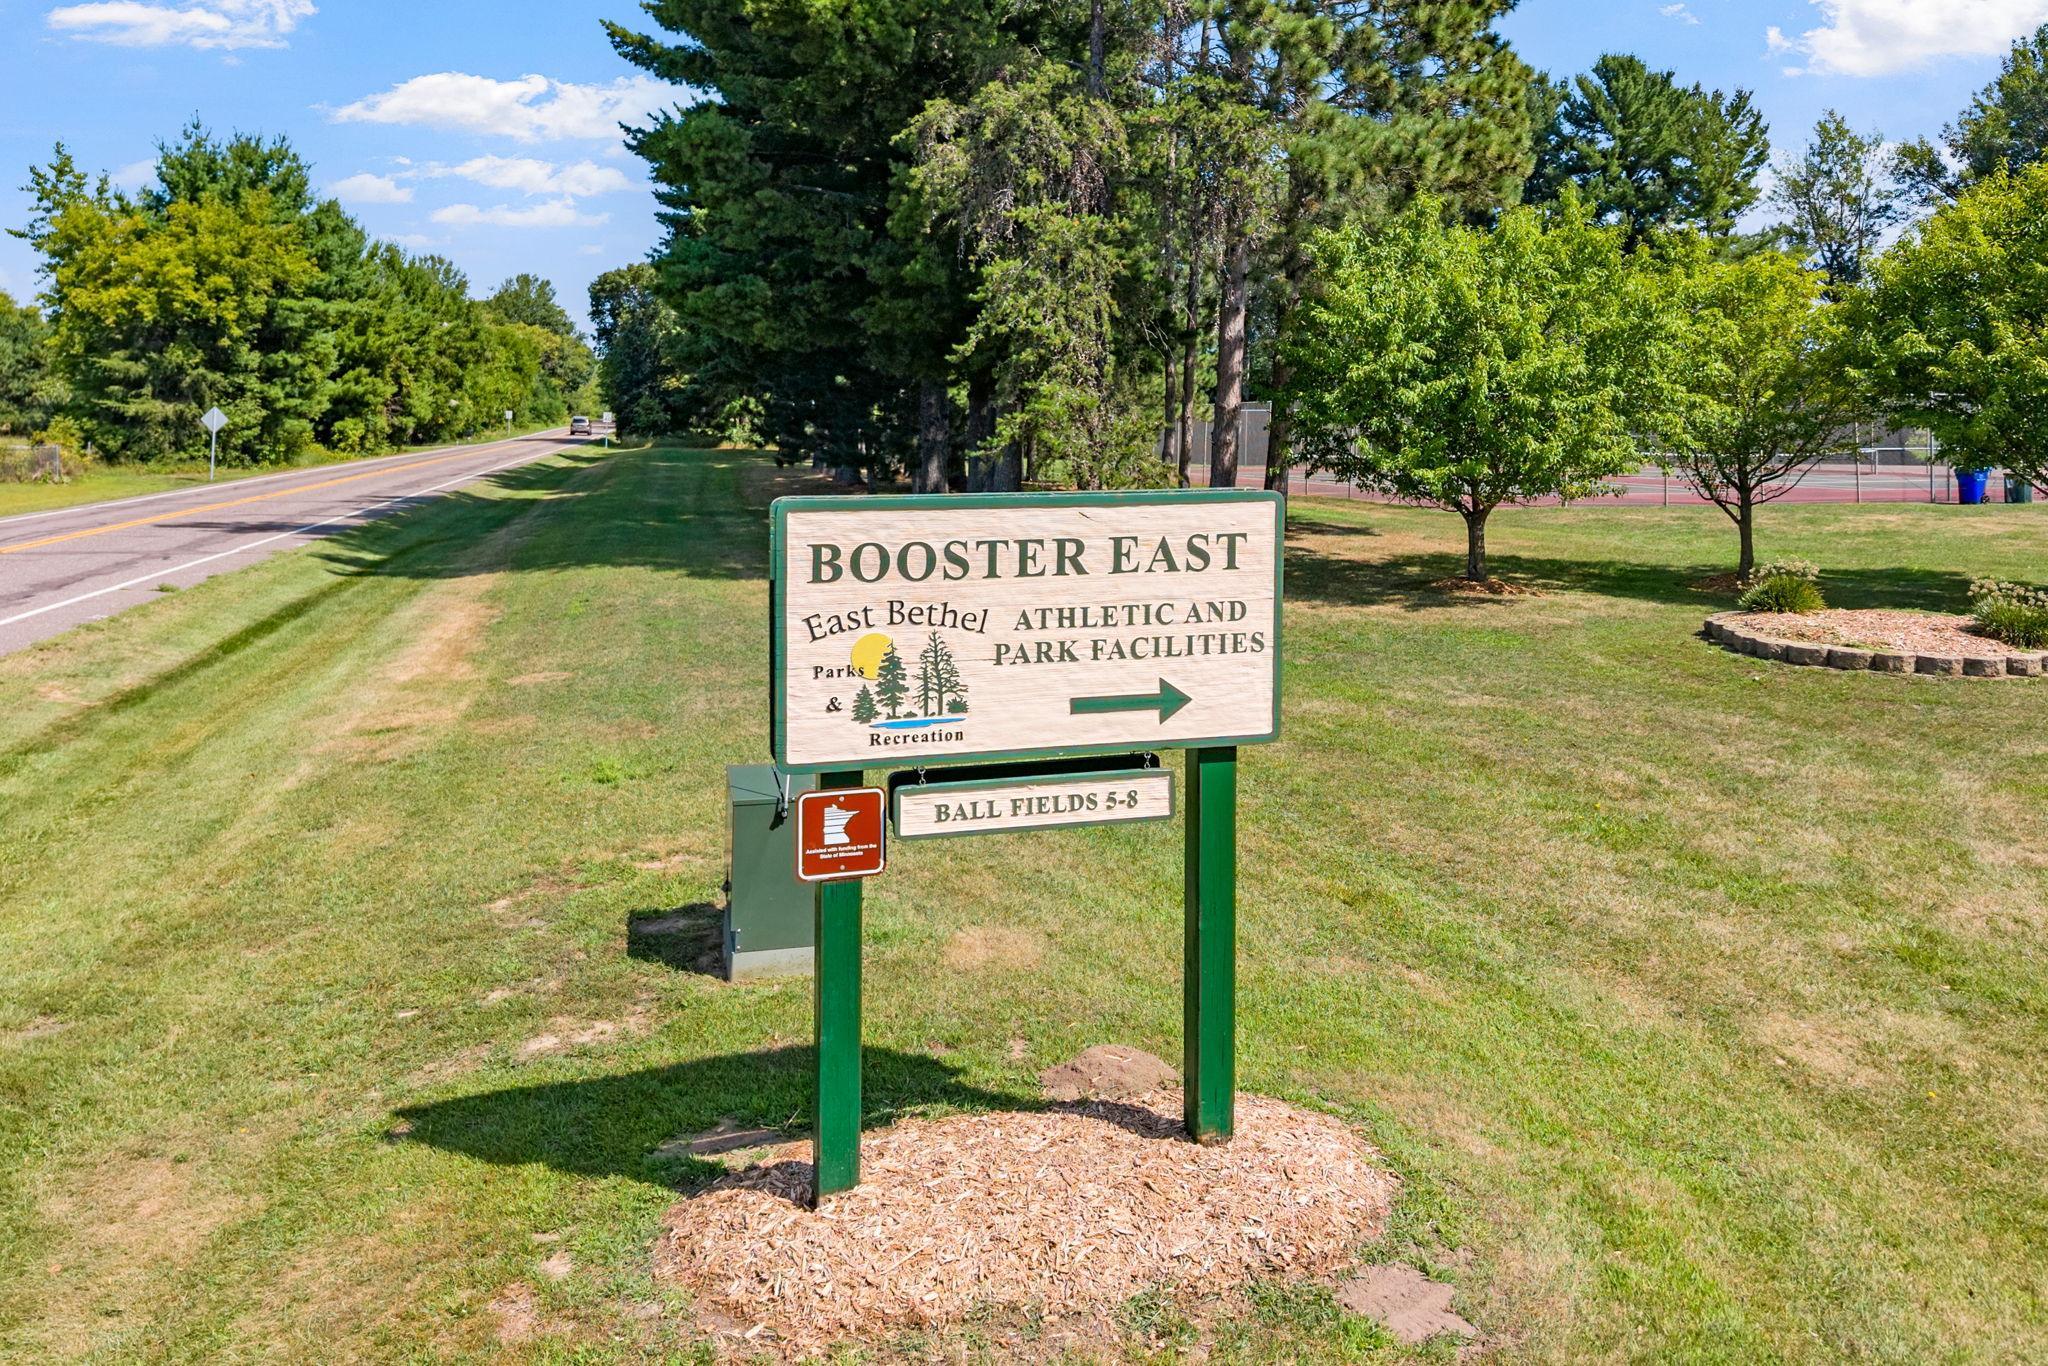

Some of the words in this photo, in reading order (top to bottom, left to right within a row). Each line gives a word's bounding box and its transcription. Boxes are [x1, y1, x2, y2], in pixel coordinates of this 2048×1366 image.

[806, 538, 1090, 584] BOOSTER
[1107, 533, 1248, 575] EAST
[801, 605, 876, 643] East
[886, 600, 988, 634] Bethel
[1013, 603, 1175, 631] ATHLETIC
[1184, 600, 1248, 623] AND
[993, 640, 1080, 666] PARK
[1090, 631, 1265, 661] FACILITIES
[812, 664, 865, 680] Parks
[826, 696, 843, 713] &
[869, 729, 964, 747] Recreation
[934, 800, 1002, 823] BALL
[1010, 793, 1098, 817] FIELDS
[1105, 789, 1139, 810] 5-8
